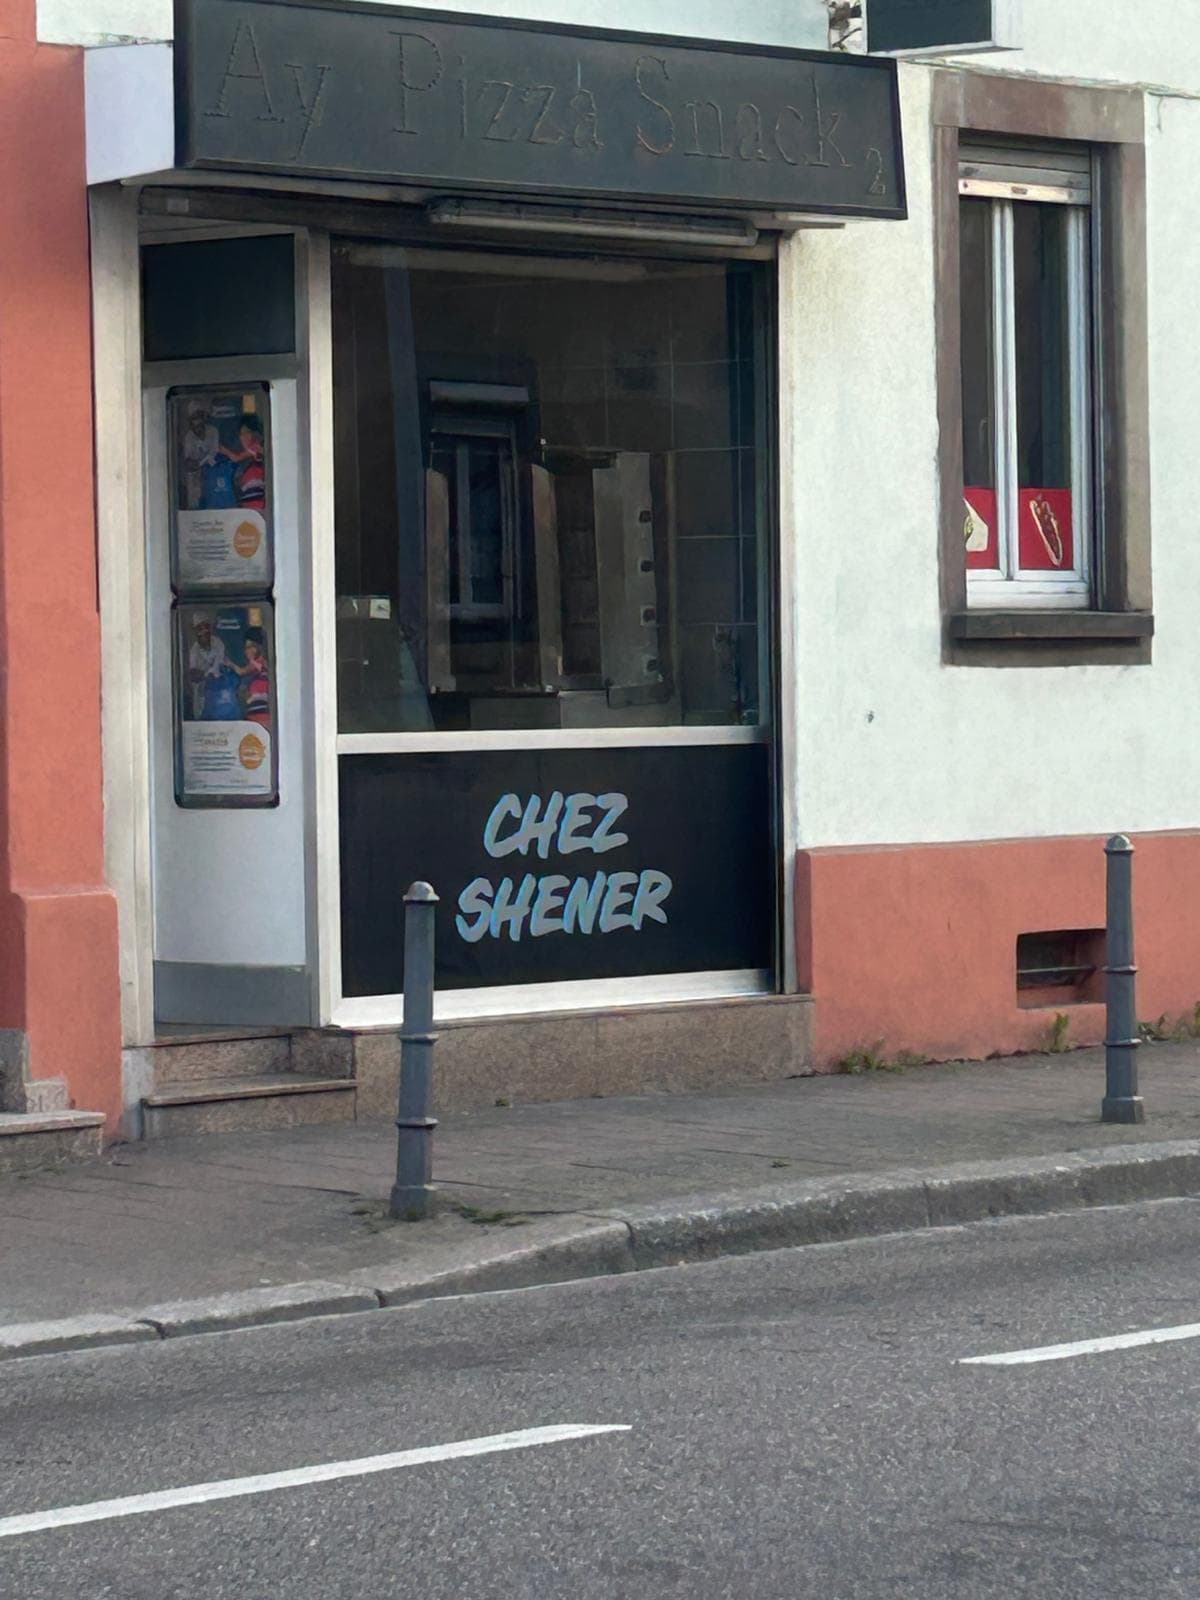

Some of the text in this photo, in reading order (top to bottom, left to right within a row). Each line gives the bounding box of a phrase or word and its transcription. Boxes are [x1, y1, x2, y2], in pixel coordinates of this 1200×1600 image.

[202, 18, 887, 196] Ay Pizza Snack 2
[483, 791, 629, 859] CHEZ
[455, 869, 673, 943] SHENER
